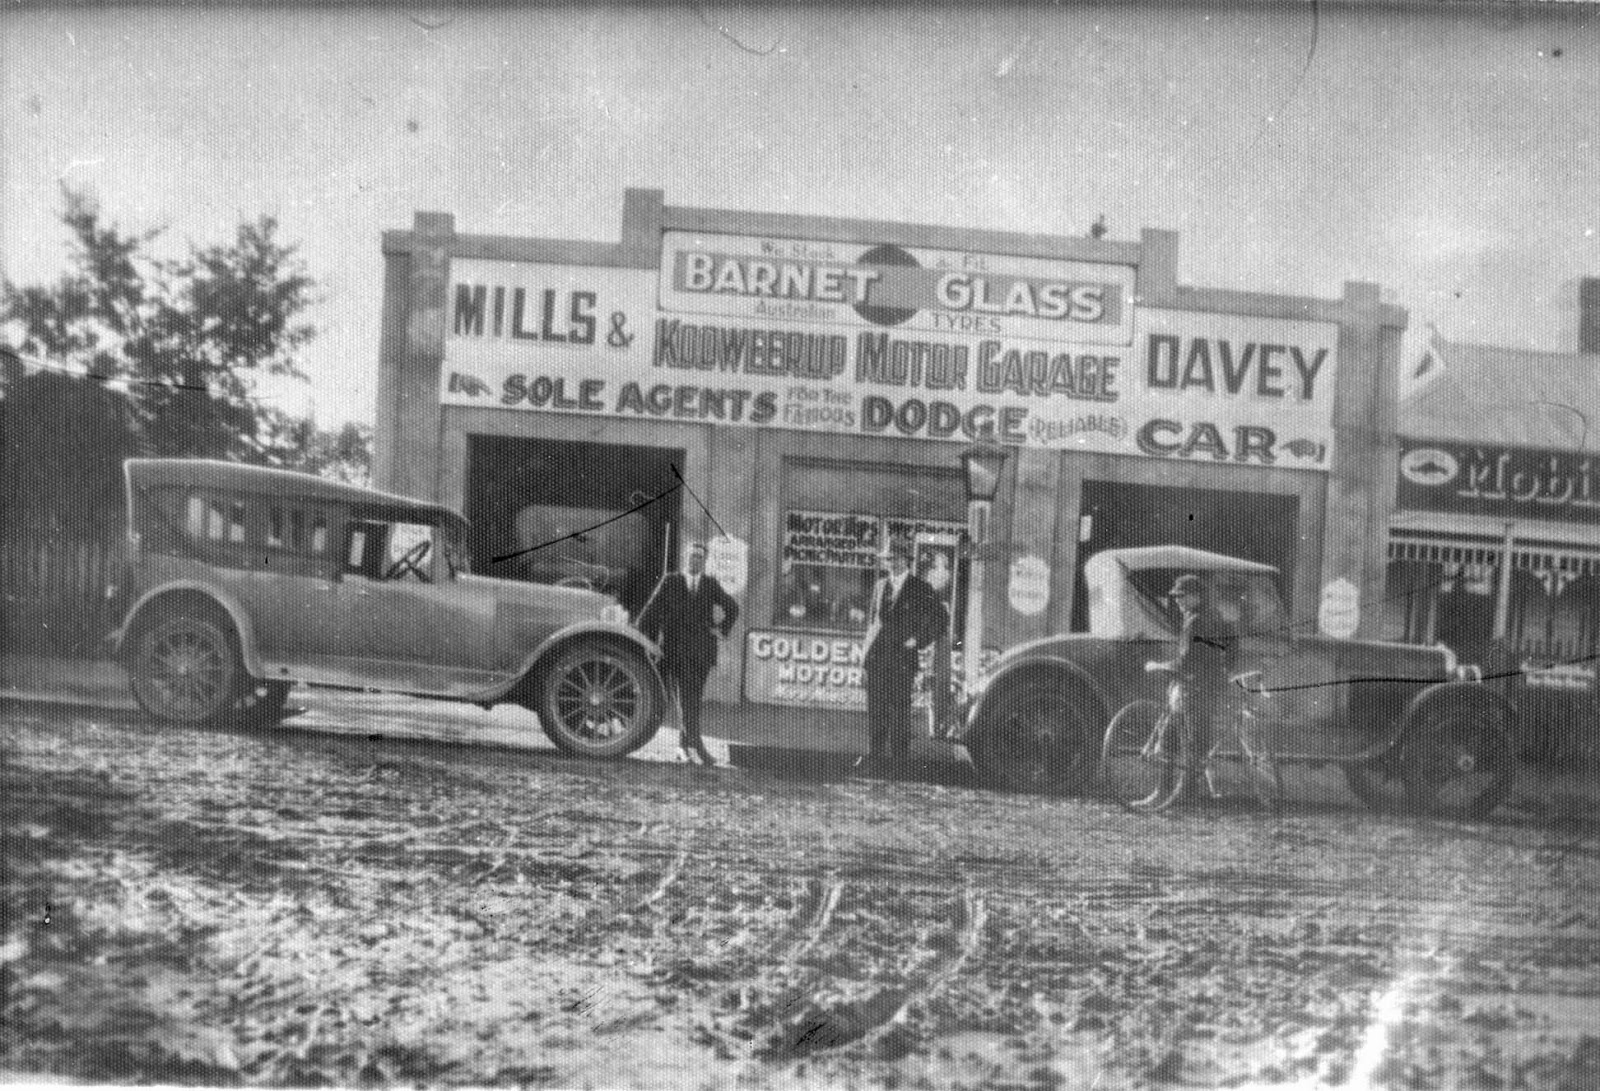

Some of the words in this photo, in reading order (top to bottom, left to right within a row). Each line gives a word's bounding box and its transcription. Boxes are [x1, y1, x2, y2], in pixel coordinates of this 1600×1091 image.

[685, 252, 880, 301] BARNET
[936, 272, 1104, 321] GLASS
[756, 299, 835, 319] Australian
[931, 312, 1002, 333] TYRES
[455, 283, 597, 345] MILLS
[607, 311, 634, 348] &
[1147, 334, 1328, 400] DAVEY
[653, 318, 848, 380] KOOWEERUP
[855, 332, 968, 392] MOTOR
[976, 340, 1121, 402] GARAGE
[502, 374, 606, 410] SOLE
[616, 381, 778, 423] AGENTS
[783, 403, 856, 427] FAMOUS
[860, 396, 1029, 444] DODGE
[1135, 418, 1277, 463] CAR
[752, 633, 866, 665] GOLDEN
[778, 664, 864, 688] MOTOR
